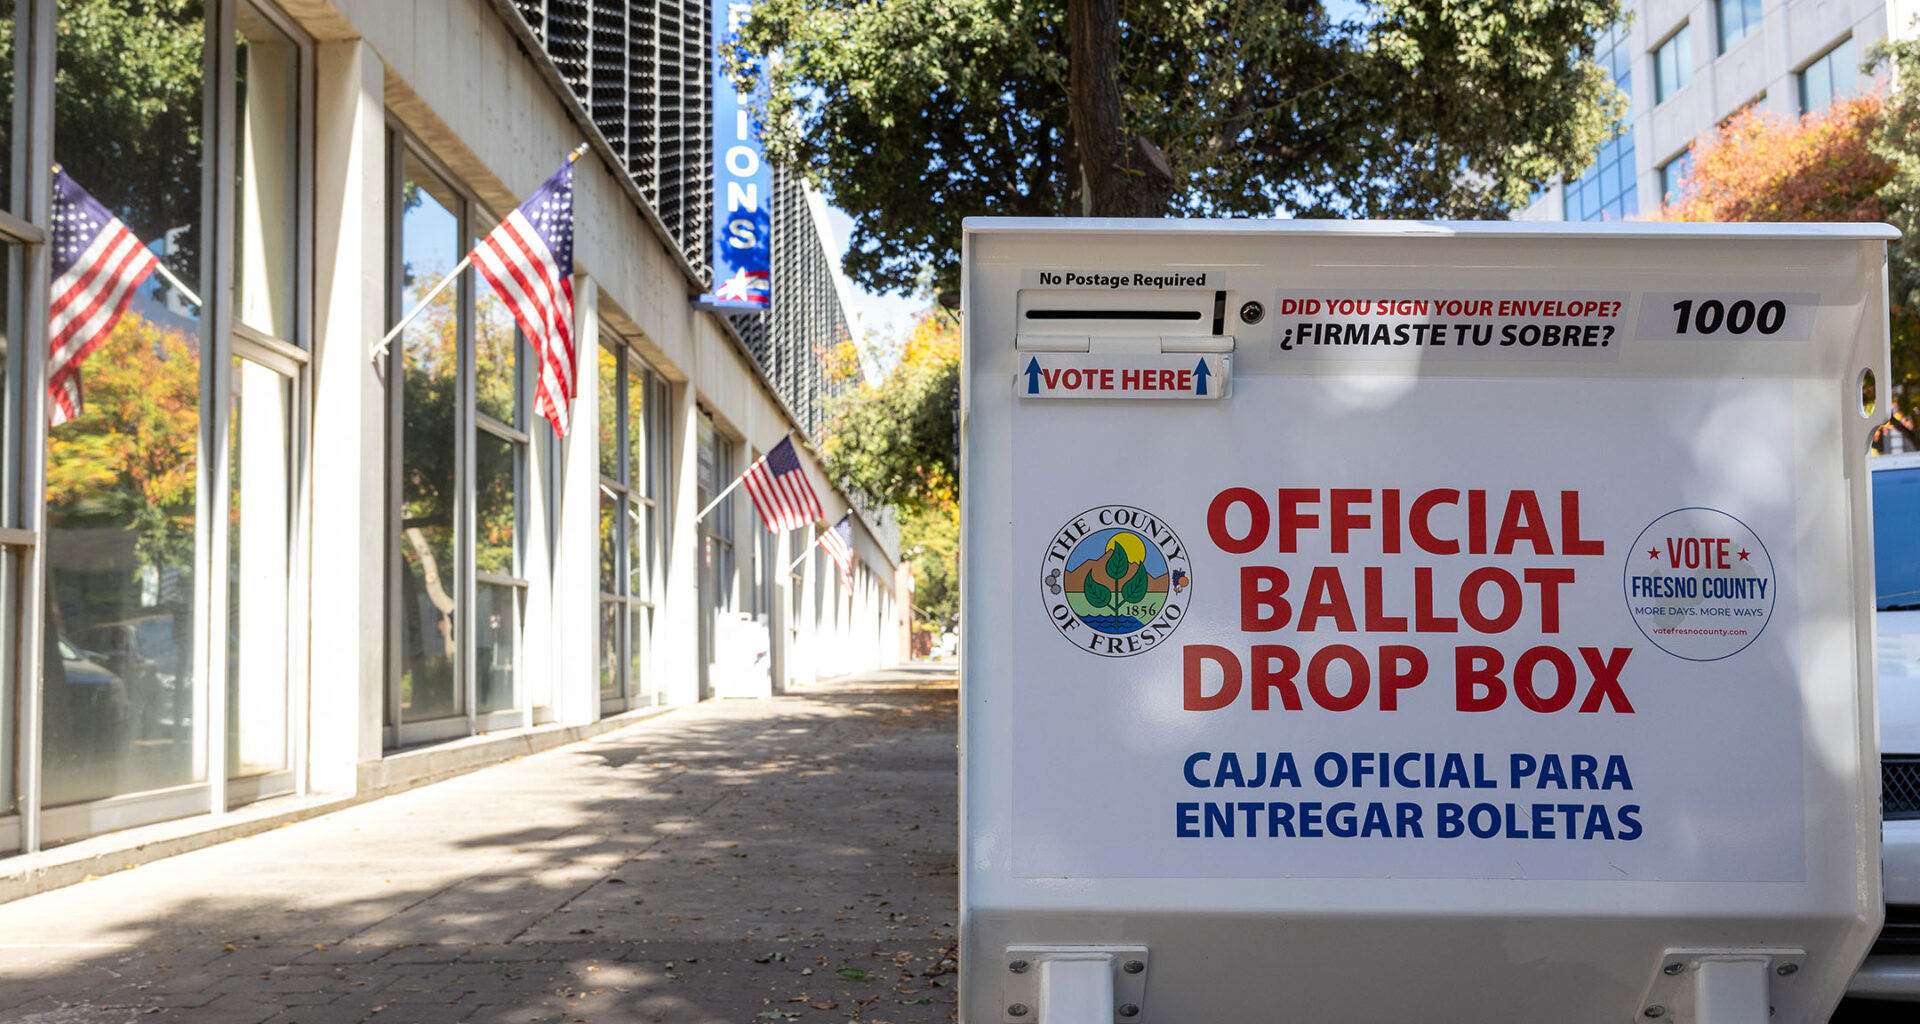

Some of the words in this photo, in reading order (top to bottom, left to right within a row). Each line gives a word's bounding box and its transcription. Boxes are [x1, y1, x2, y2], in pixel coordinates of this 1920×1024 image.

[1039, 272, 1062, 286] No
[1065, 272, 1130, 289] Postage
[1133, 273, 1207, 290] Required
[1281, 299, 1321, 316] DID
[1326, 299, 1372, 316] YOU
[1375, 299, 1430, 317] SIGN
[1433, 300, 1494, 317] YOUR
[1497, 301, 1622, 318] ENVELOPE?
[1672, 299, 1787, 335] 1000
[1280, 323, 1448, 351] ¿FIRMASTE
[1453, 324, 1494, 347] TU
[1499, 325, 1616, 348] SOBRE?
[1042, 368, 1115, 391] VOTE
[1121, 369, 1193, 391] HERE
[1048, 518, 1091, 563] THE
[1099, 509, 1185, 562] COUNTY
[1206, 487, 1605, 556] OFFICIAL
[1666, 537, 1731, 569] VOTE
[1240, 565, 1576, 634] BALLOT
[1632, 576, 1698, 599] FRESNO
[1702, 577, 1768, 600] COUNTY
[1126, 602, 1157, 619] 1856
[1635, 606, 1666, 616] MORE
[1668, 607, 1698, 617] DAYS.
[1700, 607, 1731, 617] MORE
[1733, 608, 1763, 617] WAYS
[1052, 604, 1081, 632] OF
[1088, 604, 1181, 654] FRESNO
[1652, 627, 1748, 637] votefresnocounty.com
[1183, 644, 1429, 712] DROP
[1455, 645, 1636, 714] BOX
[1183, 751, 1303, 789] CAJA
[1313, 751, 1499, 790] OFICIAL
[1509, 752, 1634, 791] PARA
[1175, 799, 1425, 840] ENTREGAR
[1435, 801, 1643, 842] BOLETAS
